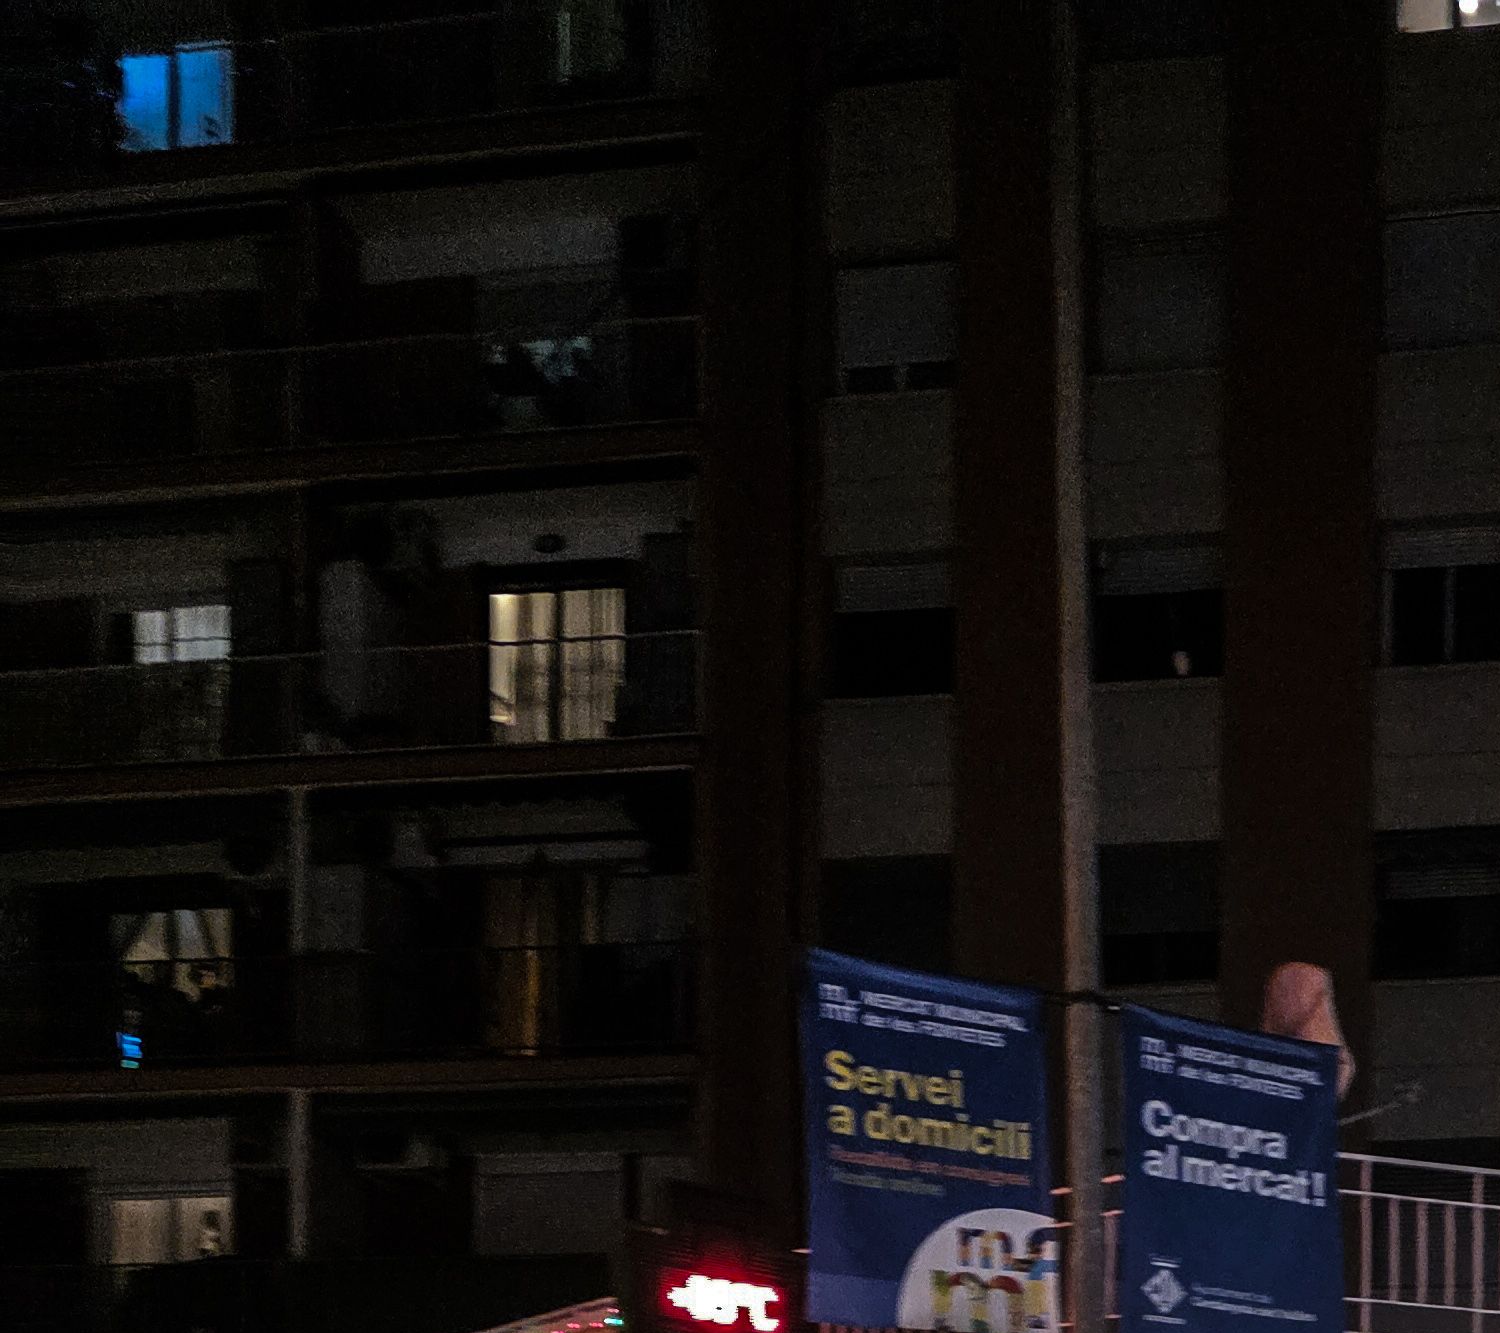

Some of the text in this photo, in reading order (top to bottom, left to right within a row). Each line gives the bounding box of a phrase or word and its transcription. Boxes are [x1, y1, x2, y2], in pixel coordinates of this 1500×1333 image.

[824, 1050, 965, 1108] Servei
[826, 1102, 1033, 1160] a domicili
[1140, 1100, 1288, 1160] Compra
[1141, 1143, 1327, 1207] al mercat!
